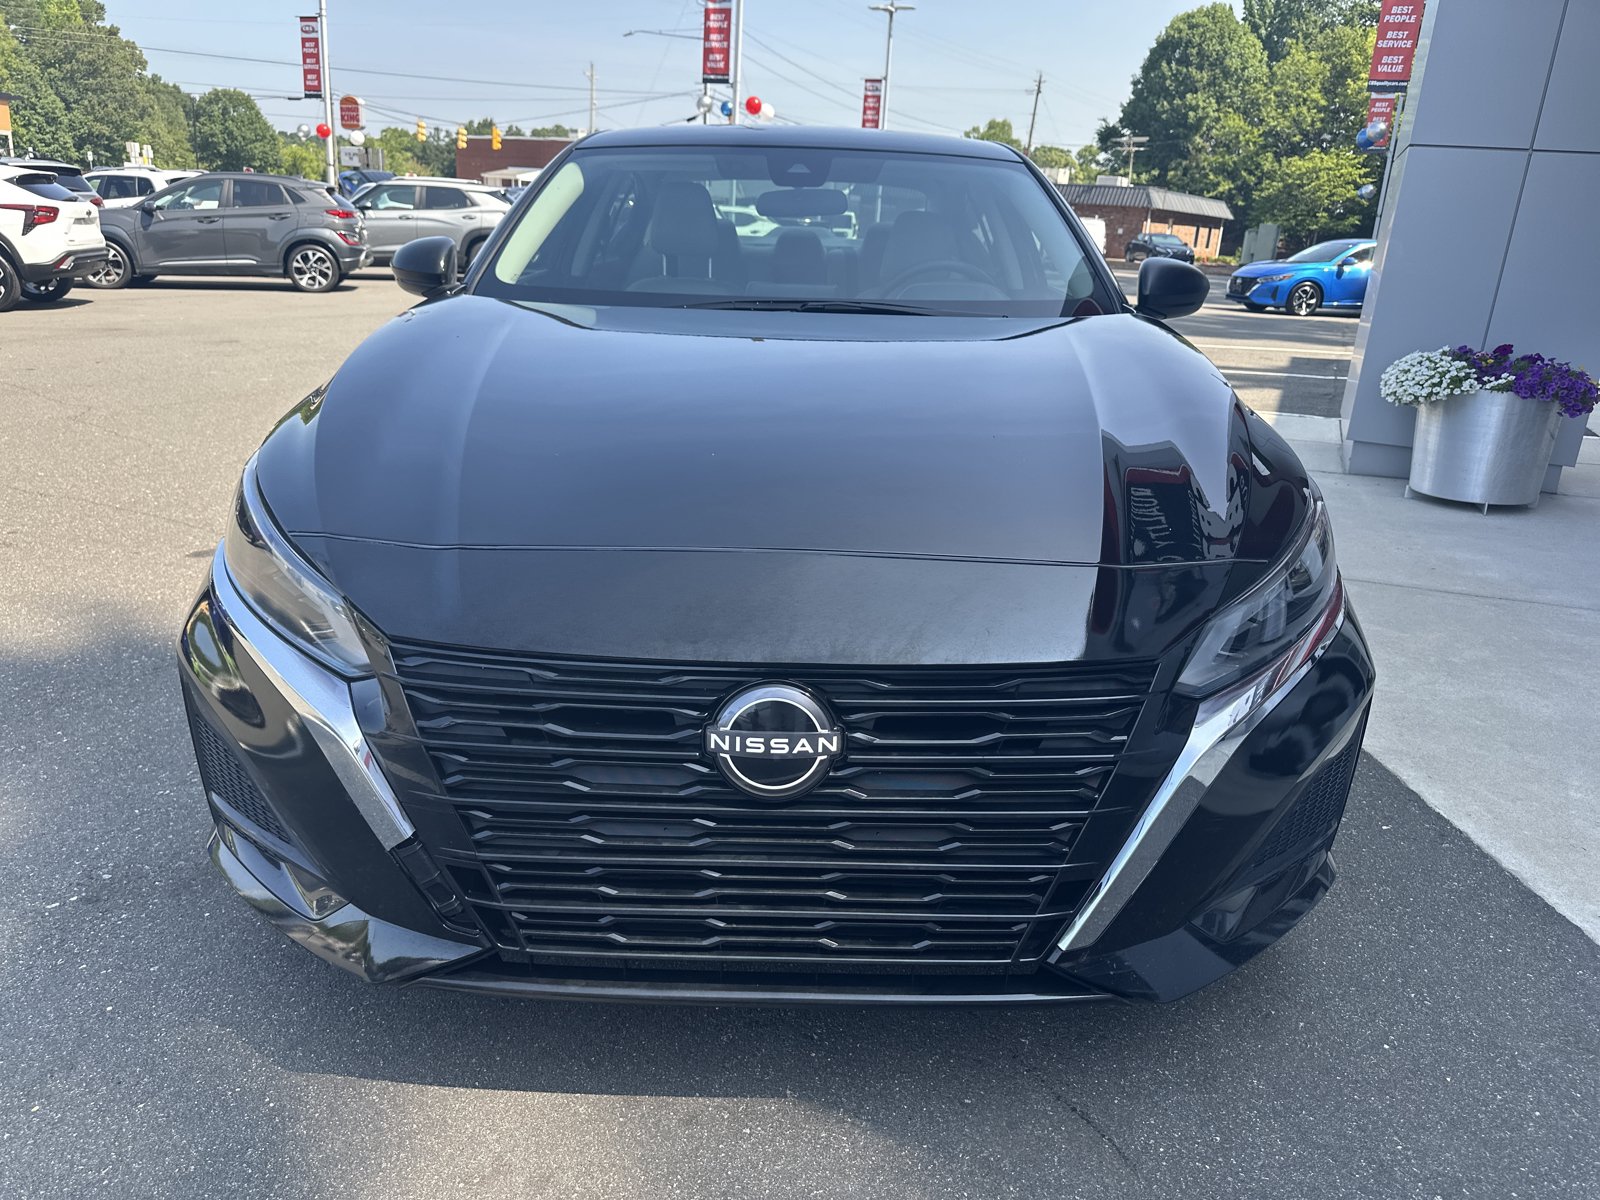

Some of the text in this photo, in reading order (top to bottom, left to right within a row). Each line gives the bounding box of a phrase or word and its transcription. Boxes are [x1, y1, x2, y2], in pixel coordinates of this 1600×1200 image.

[1377, 40, 1413, 48] SERVICE
[341, 114, 360, 123] KING
[710, 734, 837, 754] NISSAN
